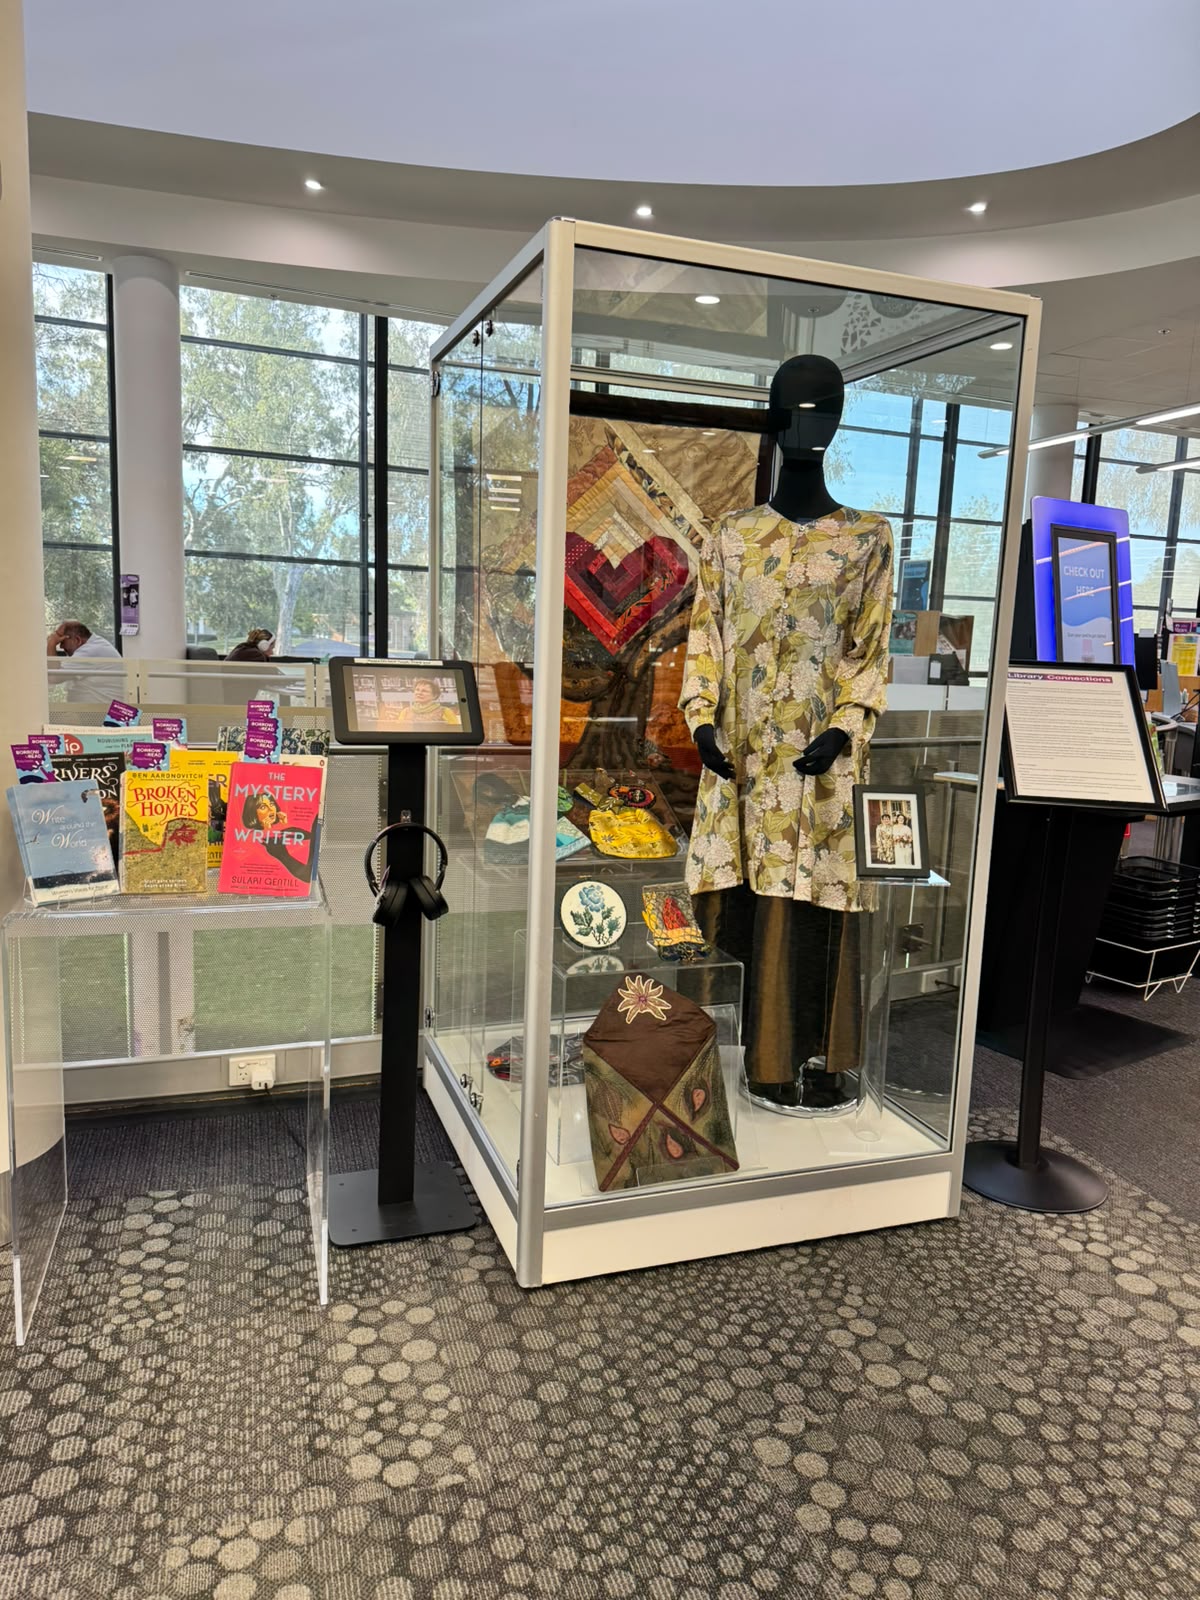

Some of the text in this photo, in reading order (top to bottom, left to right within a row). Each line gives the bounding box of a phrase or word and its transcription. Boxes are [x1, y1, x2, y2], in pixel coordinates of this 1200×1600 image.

[1063, 566, 1104, 579] CHECK OUT
[1076, 586, 1094, 597] HERE
[1008, 672, 1111, 683] Library Connections
[268, 772, 286, 781] THE
[133, 786, 198, 803] BROKEN
[234, 783, 318, 802] MYSTERY
[31, 804, 65, 824] Write
[140, 800, 199, 818] HOMES
[234, 828, 305, 846] WRITER
[231, 876, 299, 888] SULARI GENTILL
